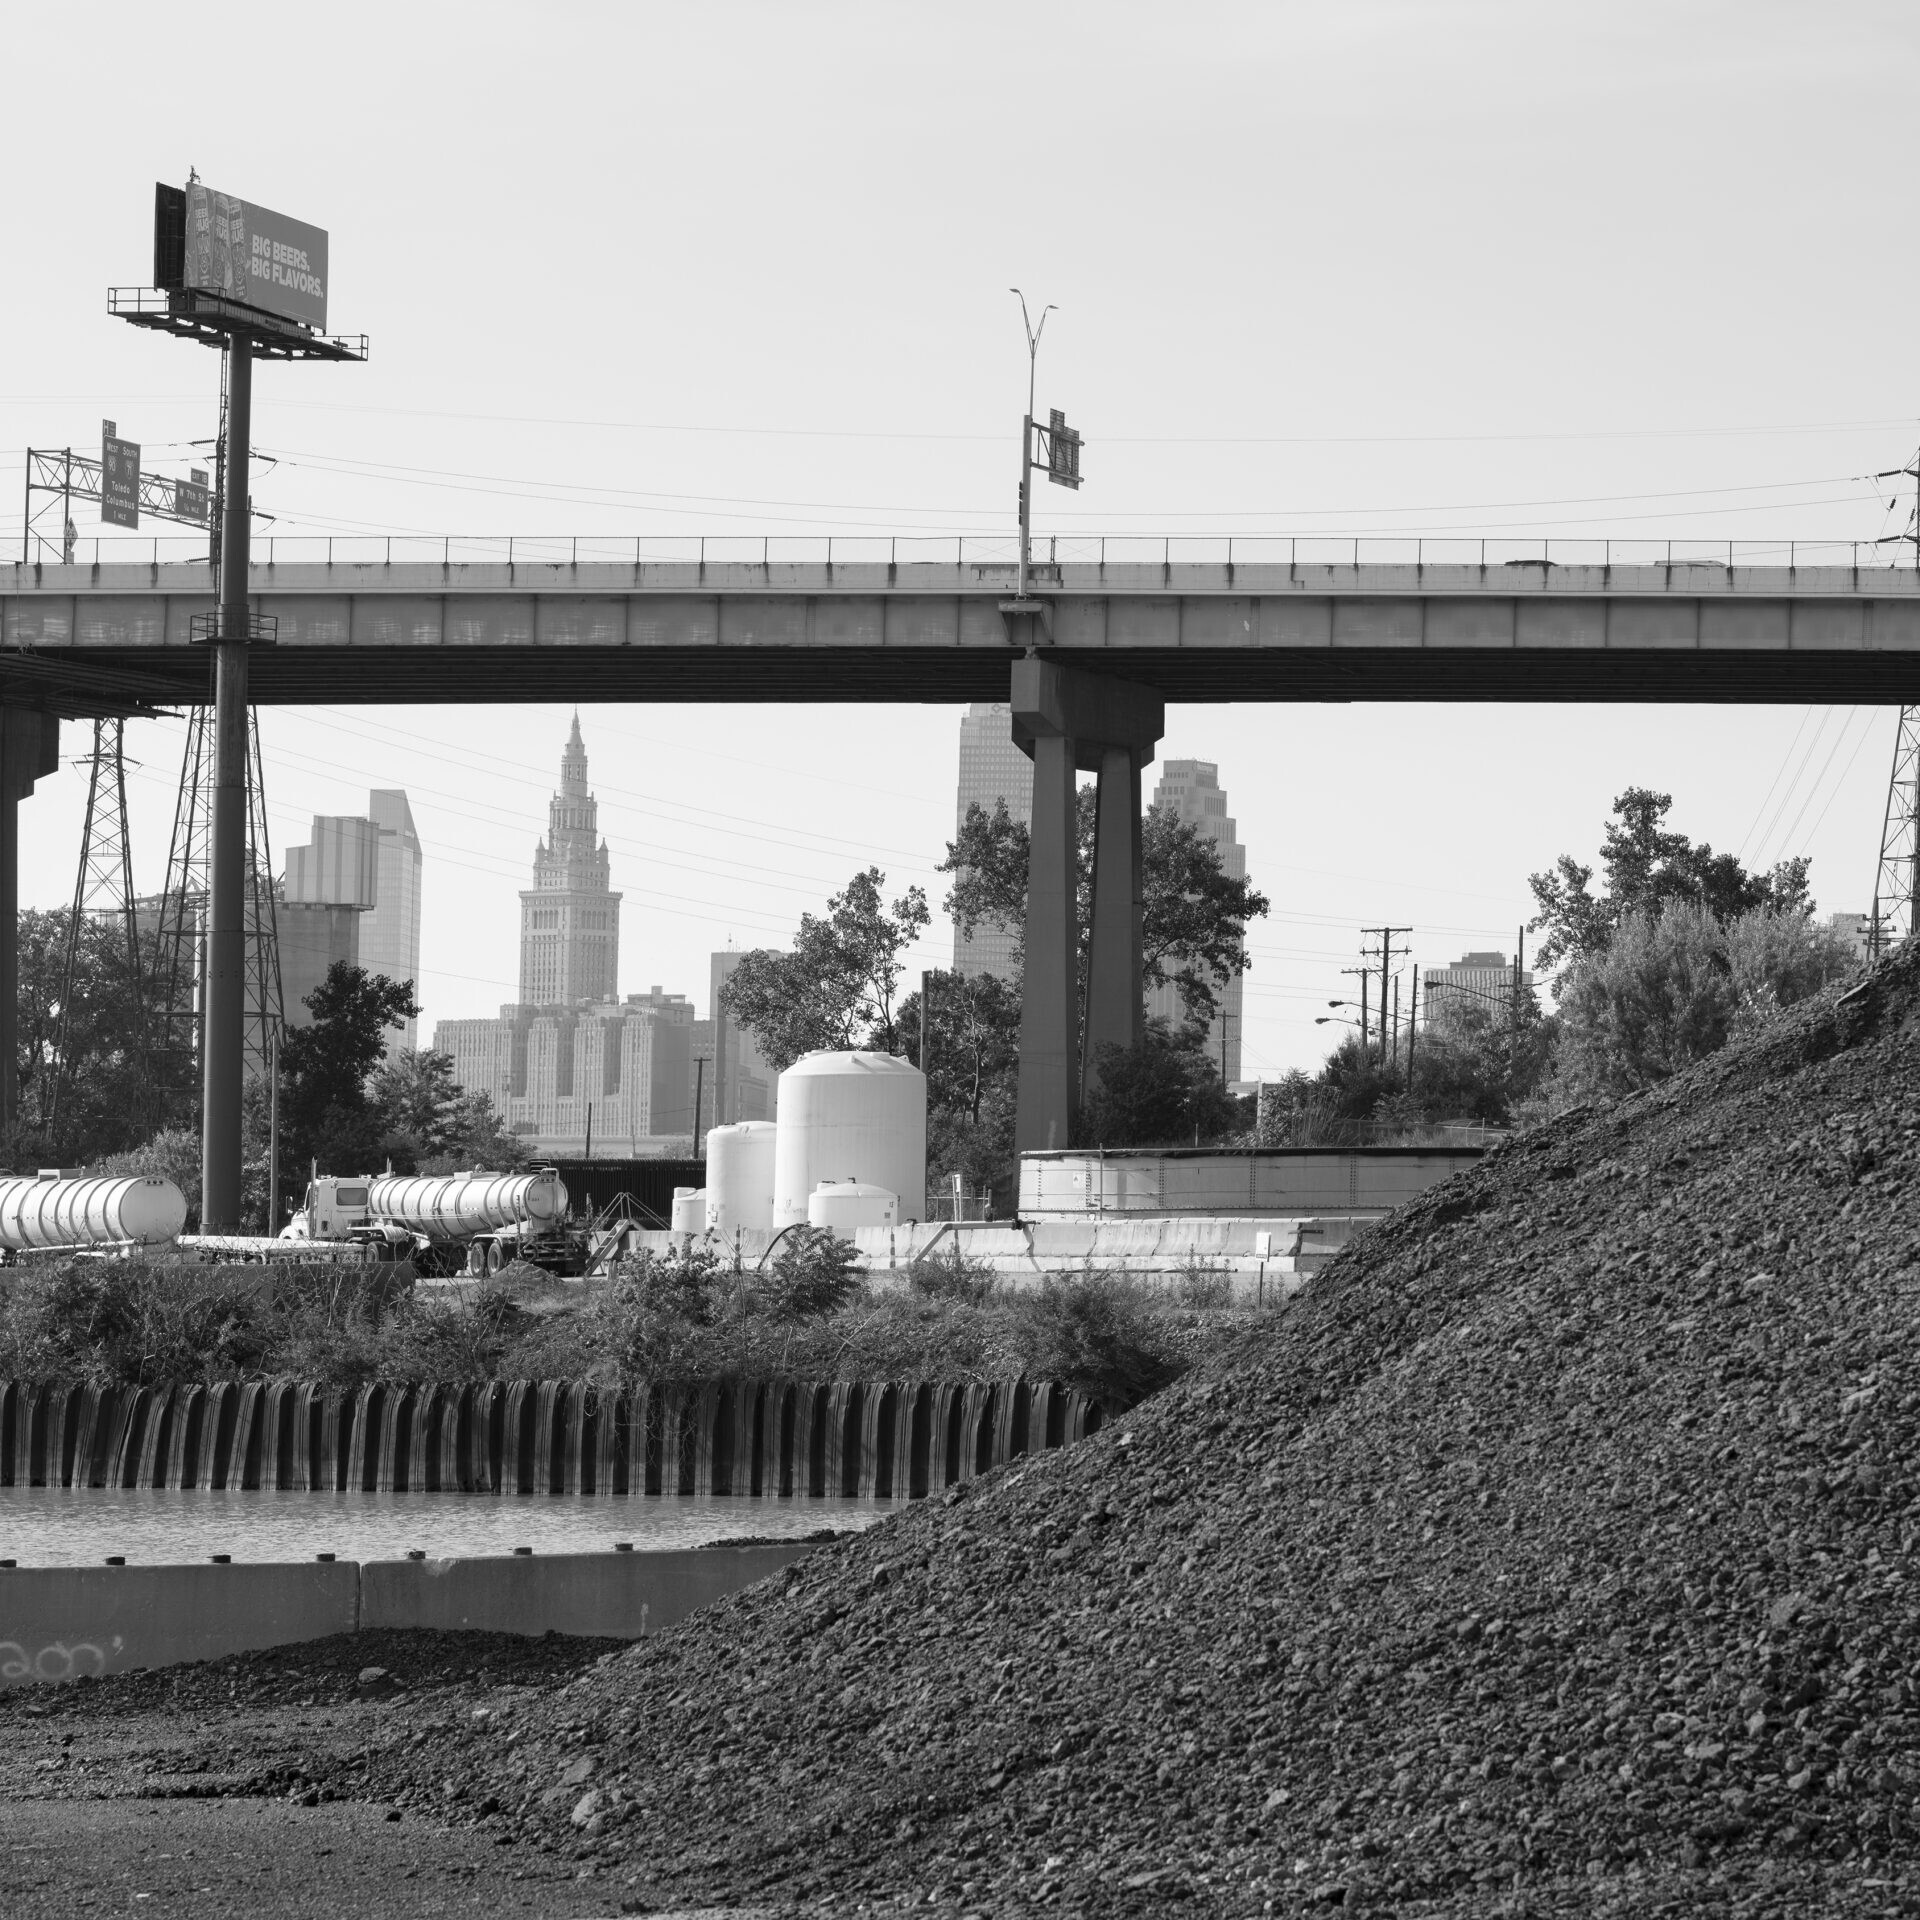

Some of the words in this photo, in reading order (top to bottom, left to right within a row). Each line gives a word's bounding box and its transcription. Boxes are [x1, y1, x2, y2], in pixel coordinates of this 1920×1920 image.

[252, 234, 271, 258] BIG
[252, 256, 271, 280] BIG
[273, 262, 323, 298] FLAVORS.
[112, 481, 130, 494] Toledo
[107, 494, 134, 510] Columbus
